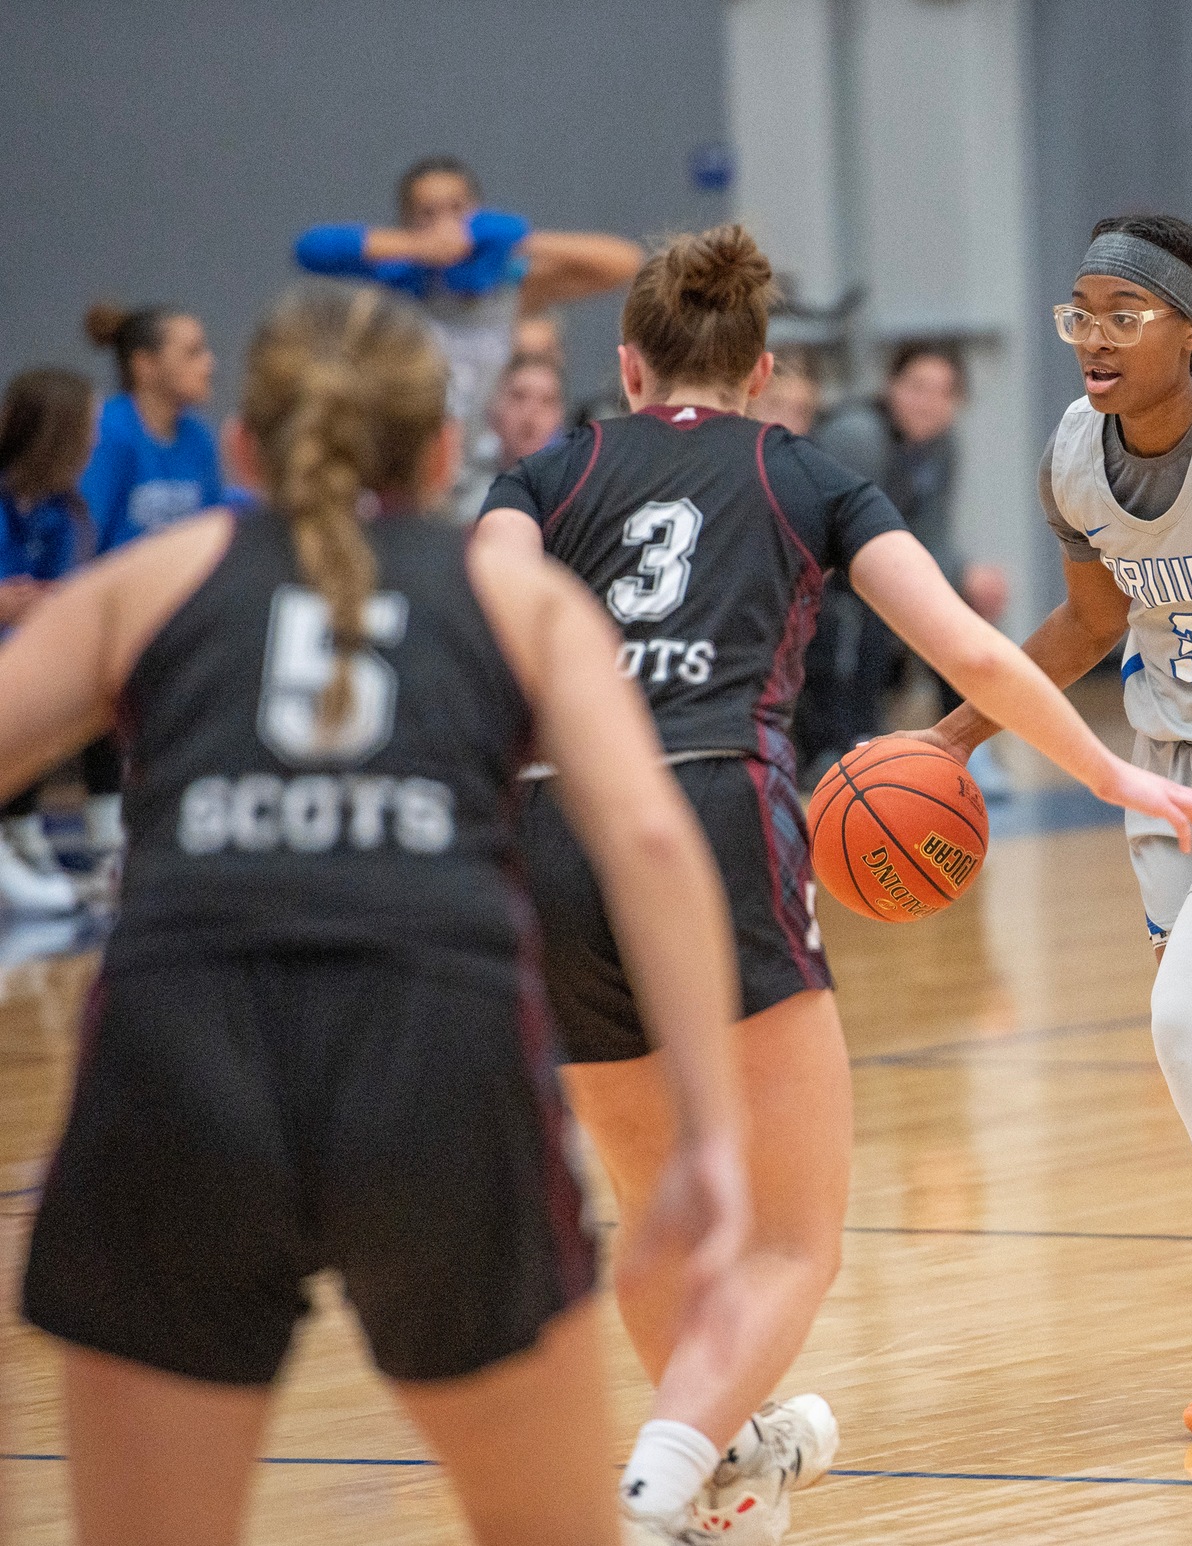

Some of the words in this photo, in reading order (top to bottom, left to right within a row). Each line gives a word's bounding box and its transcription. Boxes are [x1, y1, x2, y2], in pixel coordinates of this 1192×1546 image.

[606, 497, 704, 624] 3
[257, 582, 410, 768] 5
[616, 638, 716, 684] OTS
[177, 772, 458, 854] SCOTS
[922, 835, 979, 887] NJCAA
